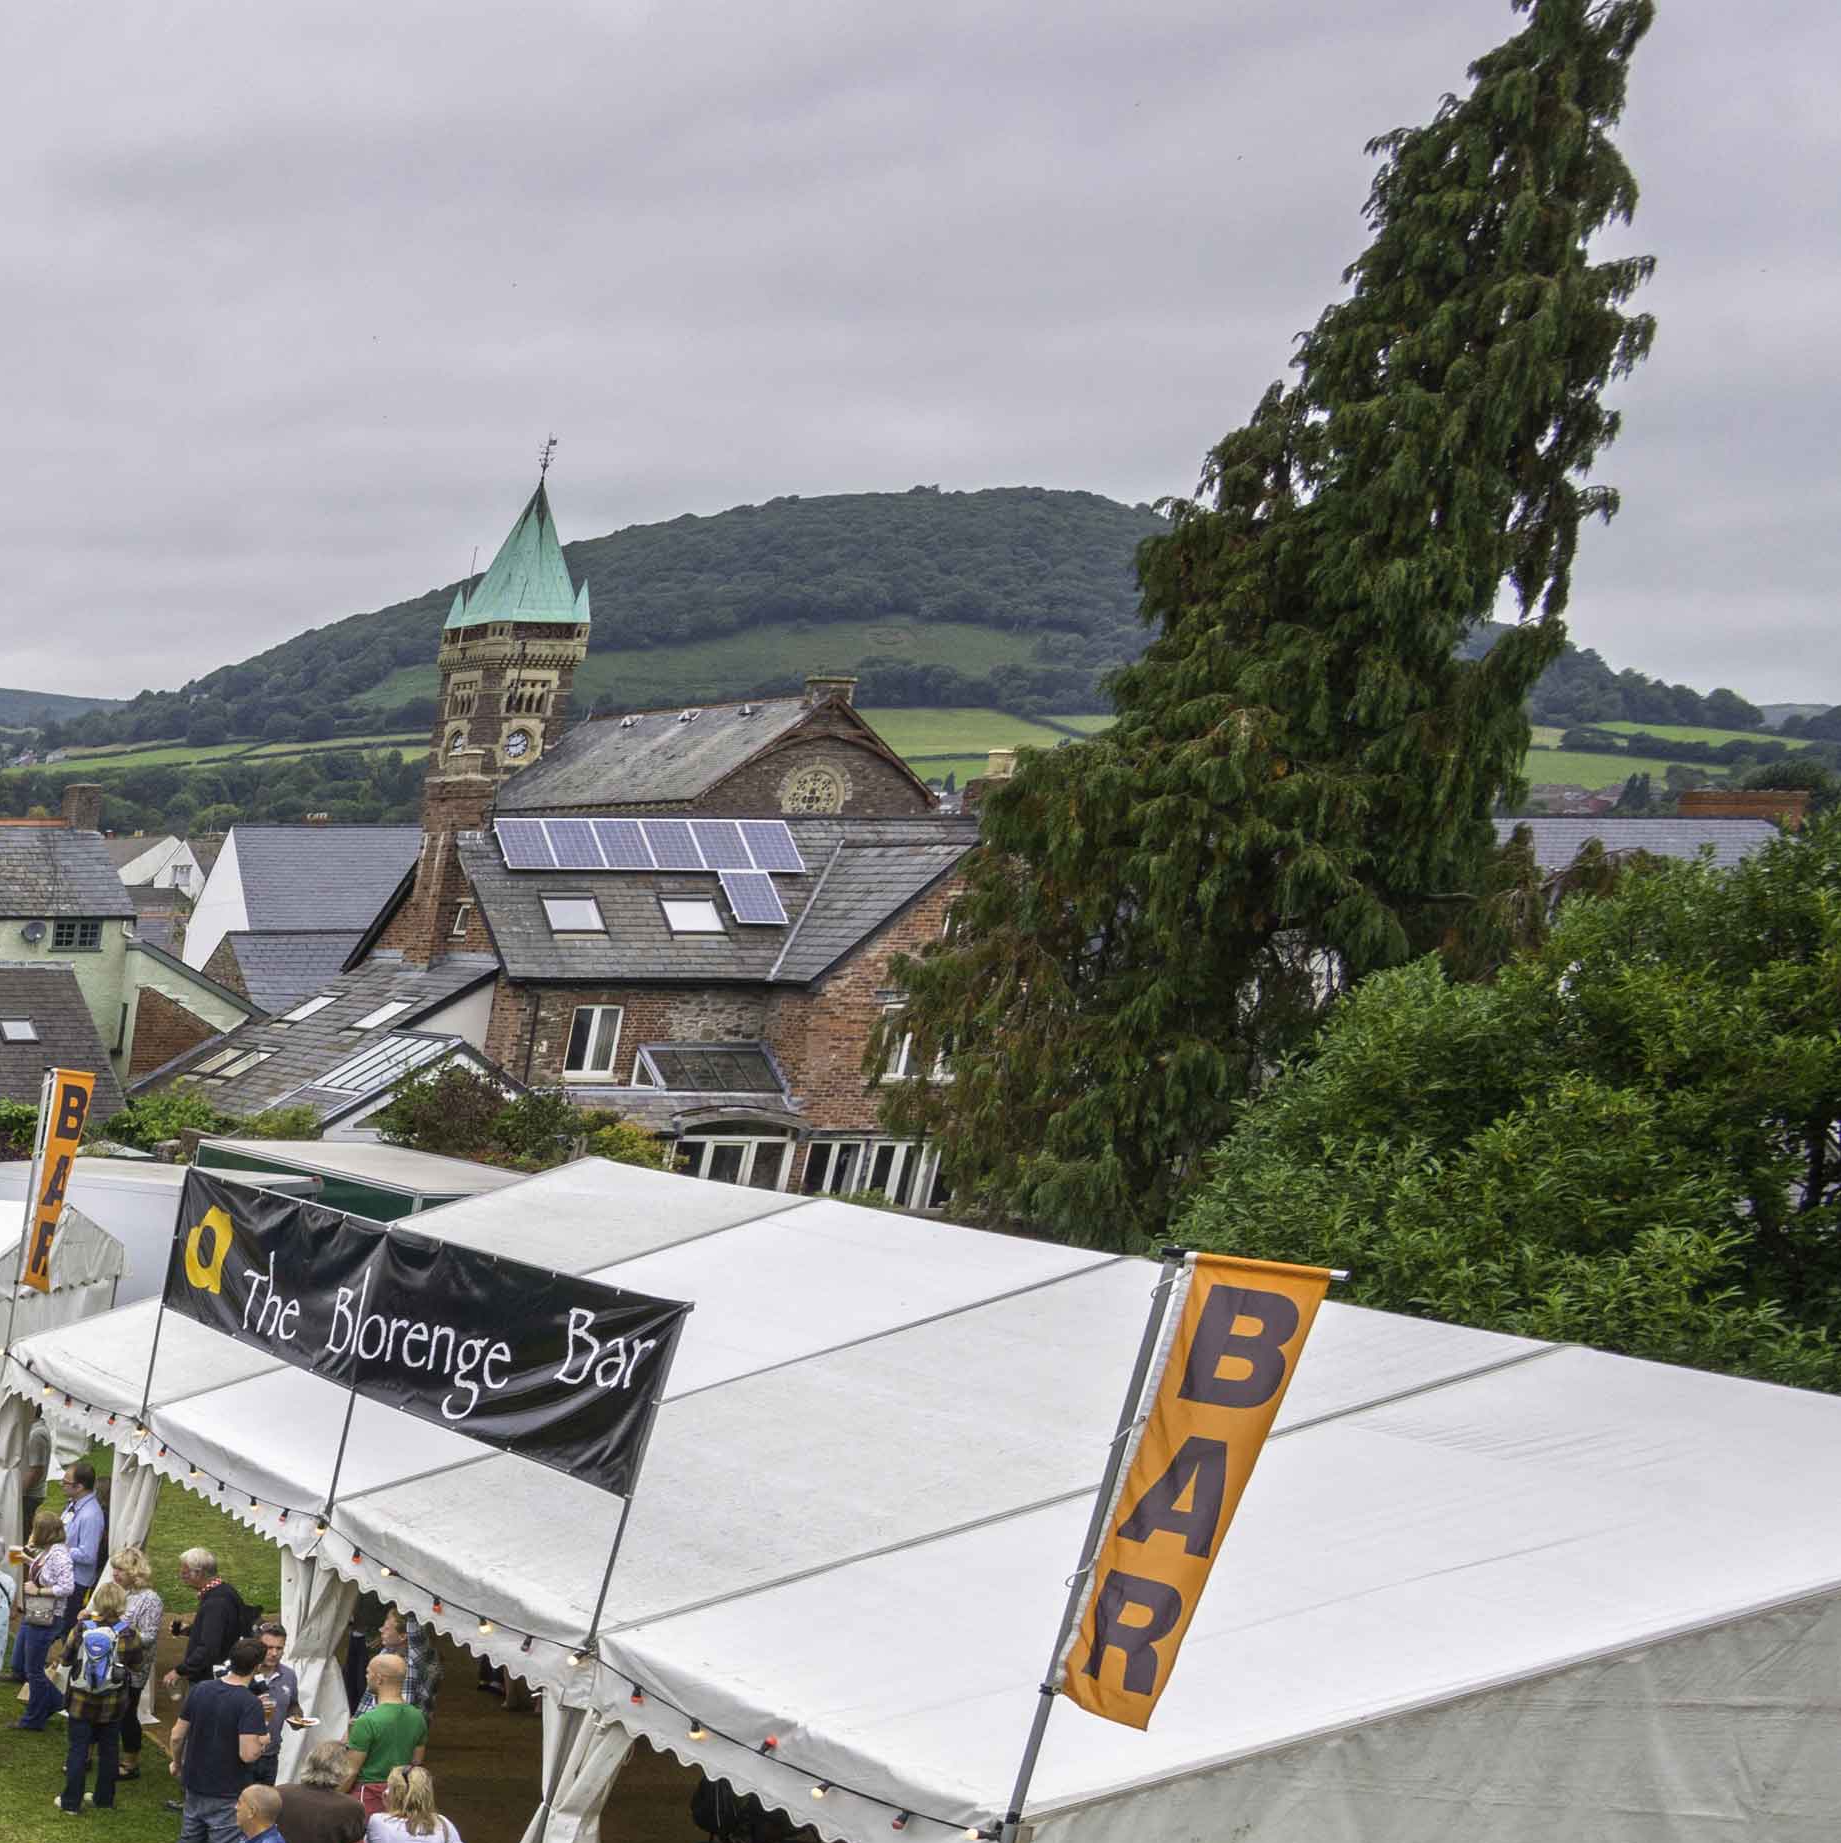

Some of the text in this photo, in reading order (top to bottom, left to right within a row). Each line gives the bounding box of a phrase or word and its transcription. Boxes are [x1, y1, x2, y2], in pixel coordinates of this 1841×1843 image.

[31, 1083, 88, 1277] BAR
[242, 1251, 656, 1420] The Blorenge Bar
[1080, 1284, 1300, 1697] BAR
